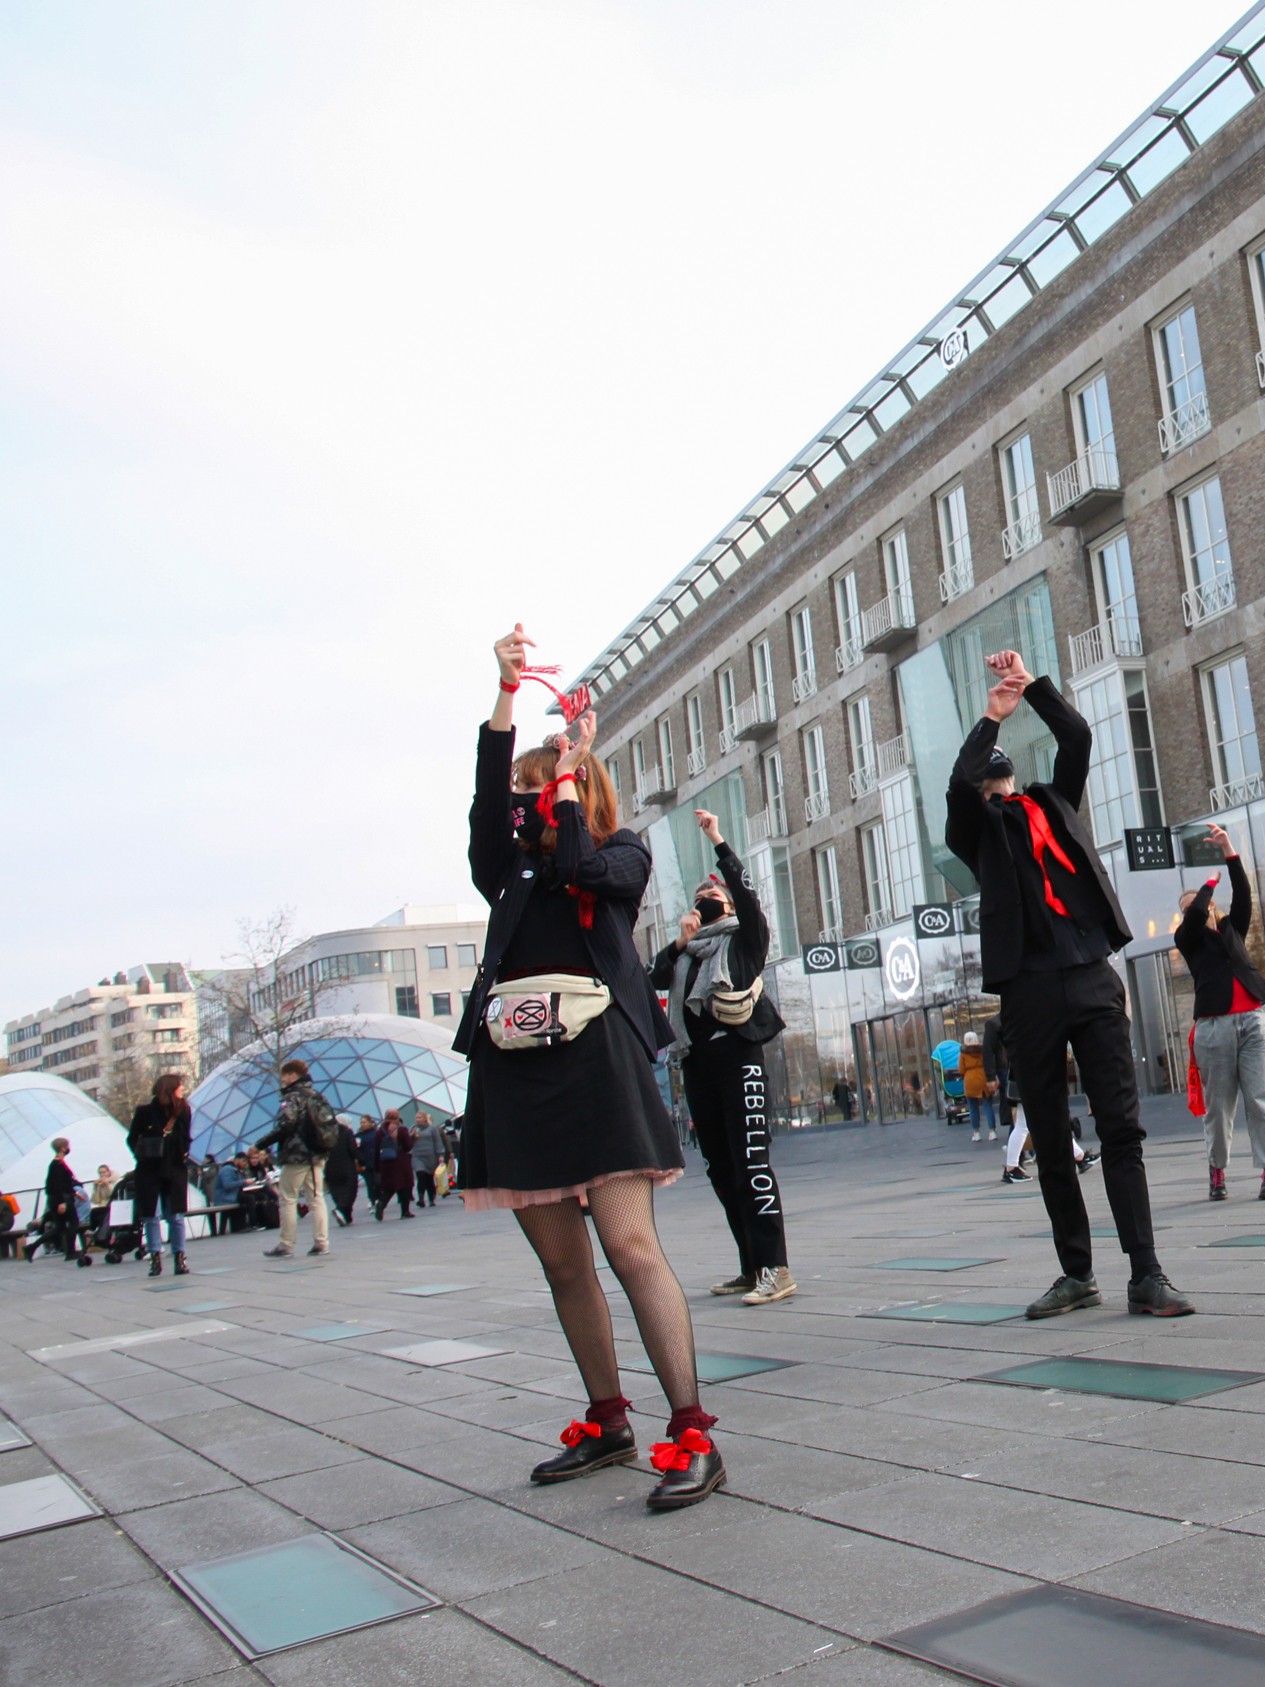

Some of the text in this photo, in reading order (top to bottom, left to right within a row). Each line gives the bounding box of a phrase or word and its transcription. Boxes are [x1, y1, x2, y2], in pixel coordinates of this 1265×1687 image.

[1136, 834, 1161, 842] RIT
[1138, 845, 1163, 853] UAL
[924, 914, 945, 927] C&A
[812, 953, 830, 963] C&A
[891, 953, 915, 984] C&A
[742, 1065, 780, 1215] REBELLION
